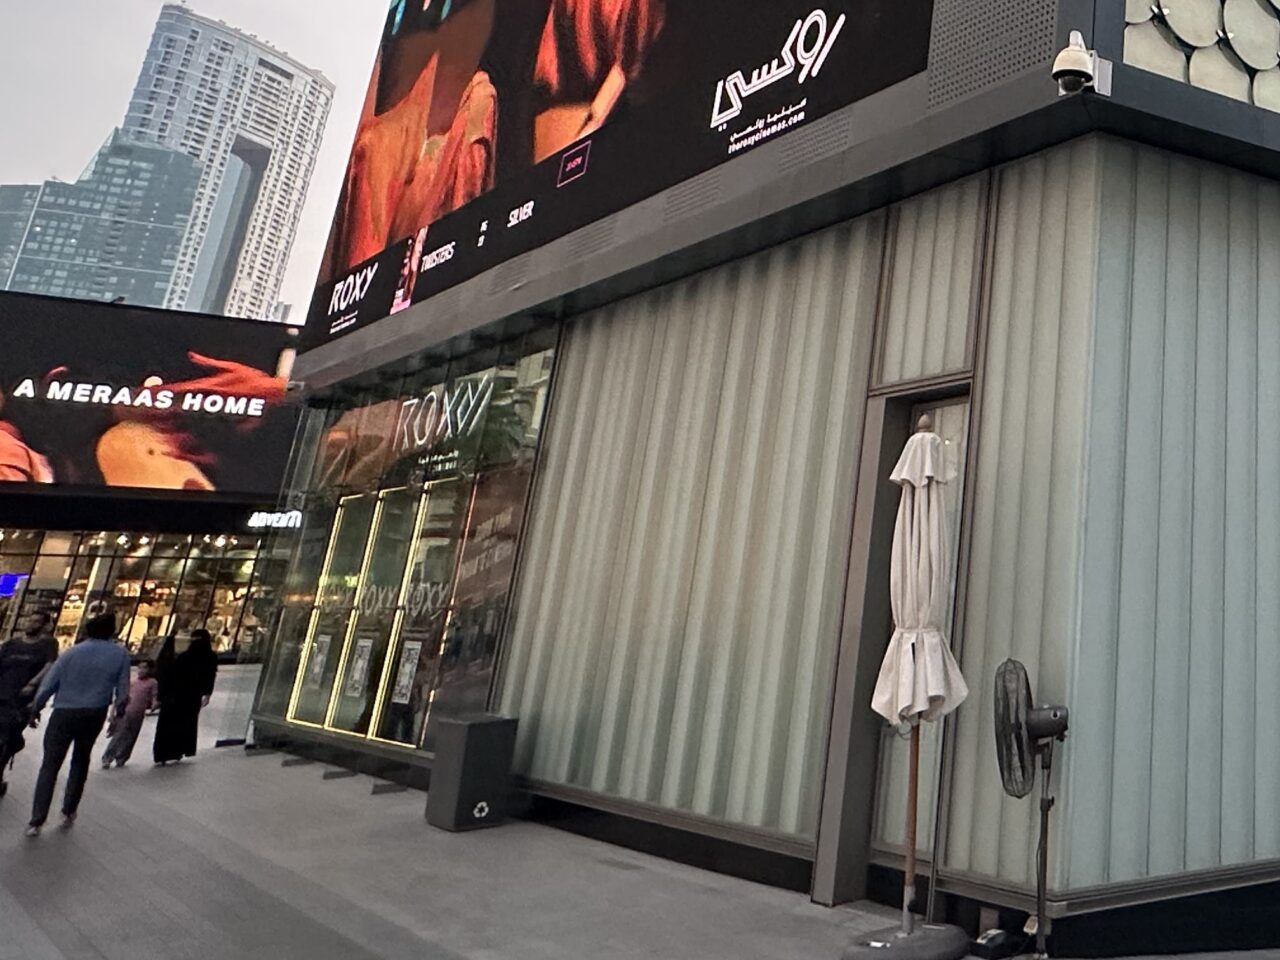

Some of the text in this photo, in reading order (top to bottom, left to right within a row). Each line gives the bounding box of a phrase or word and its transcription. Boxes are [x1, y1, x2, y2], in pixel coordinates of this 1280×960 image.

[710, 8, 846, 132] روكسي
[327, 261, 379, 316] ROXY
[13, 378, 266, 417] A MERAAS HOME
[392, 373, 494, 452] ROXY
